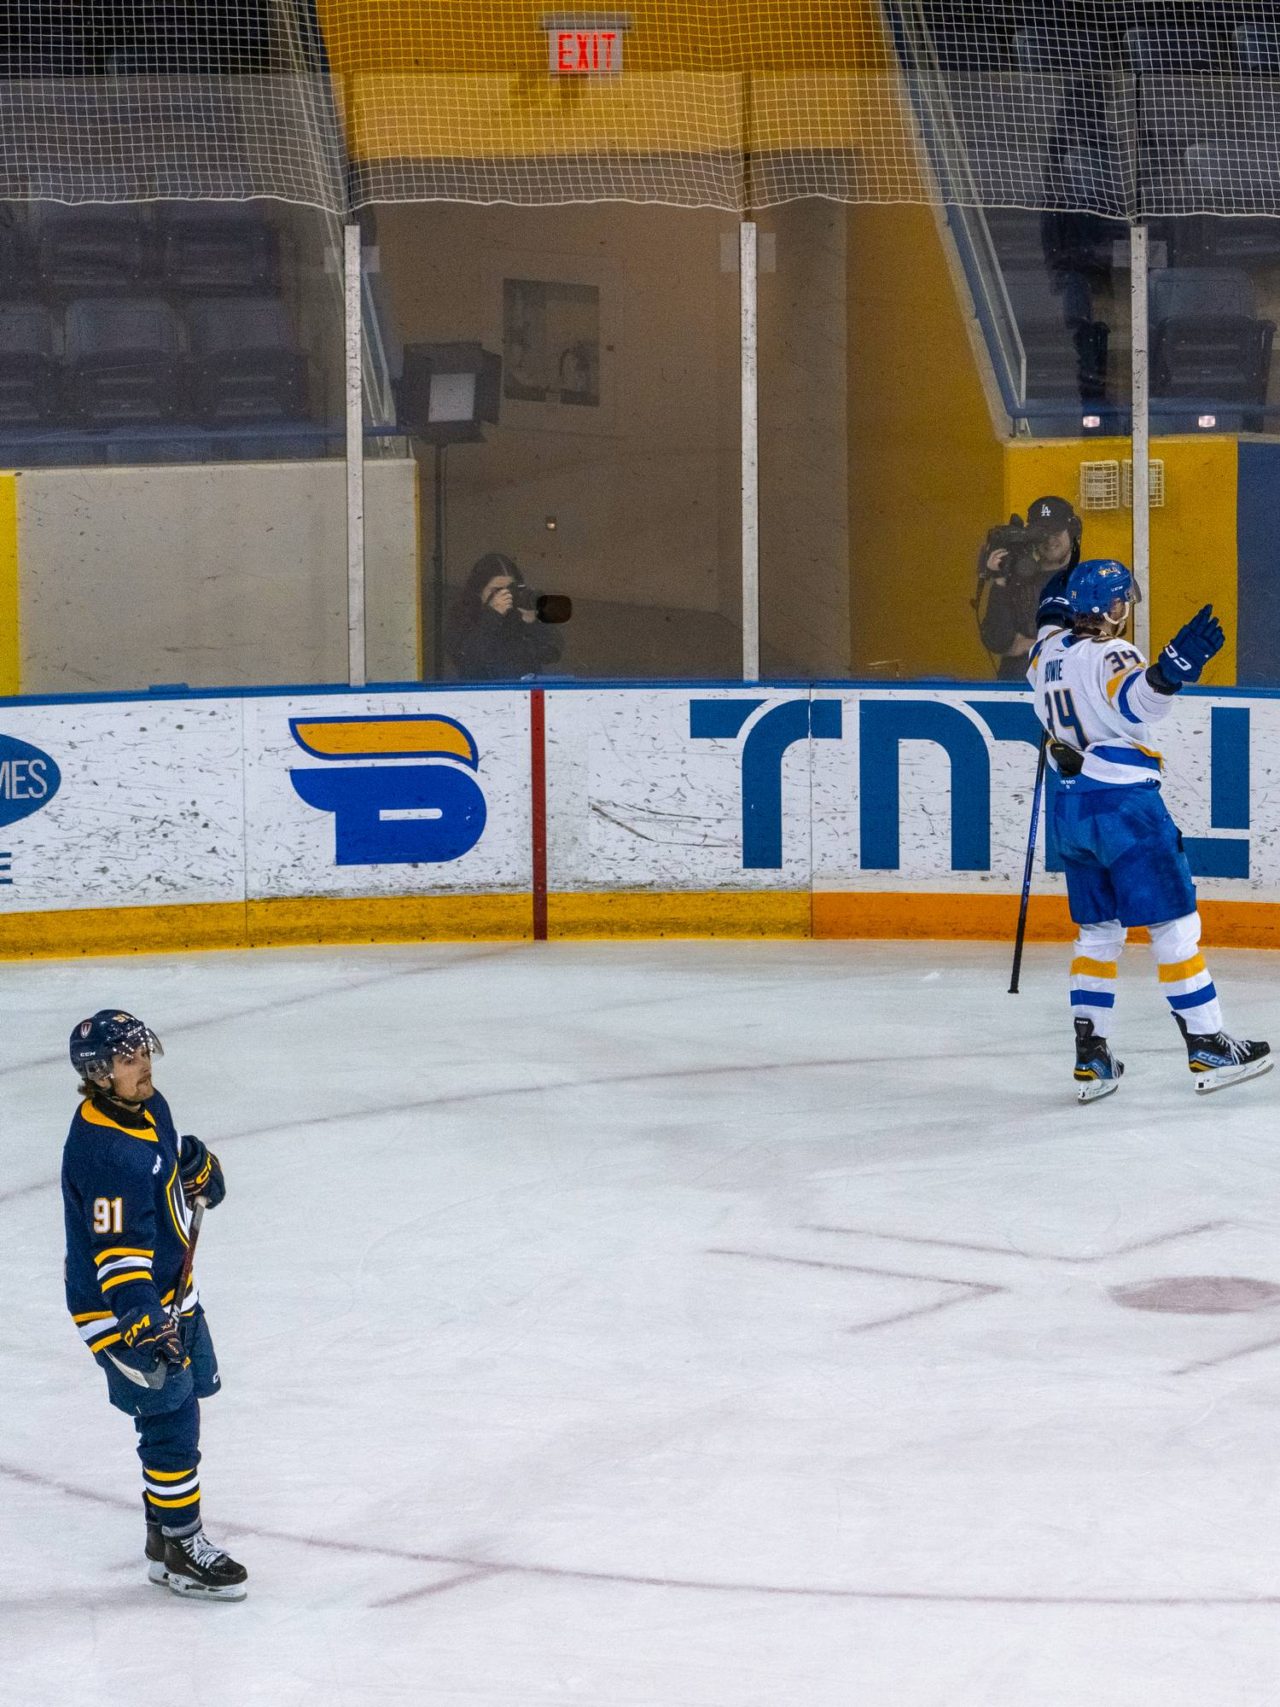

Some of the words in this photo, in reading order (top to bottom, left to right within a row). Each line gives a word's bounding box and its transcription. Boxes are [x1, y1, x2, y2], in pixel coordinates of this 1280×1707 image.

[558, 33, 616, 70] EXIT
[1040, 504, 1052, 517] LA
[1104, 649, 1143, 674] 34
[93, 1197, 123, 1234] 91
